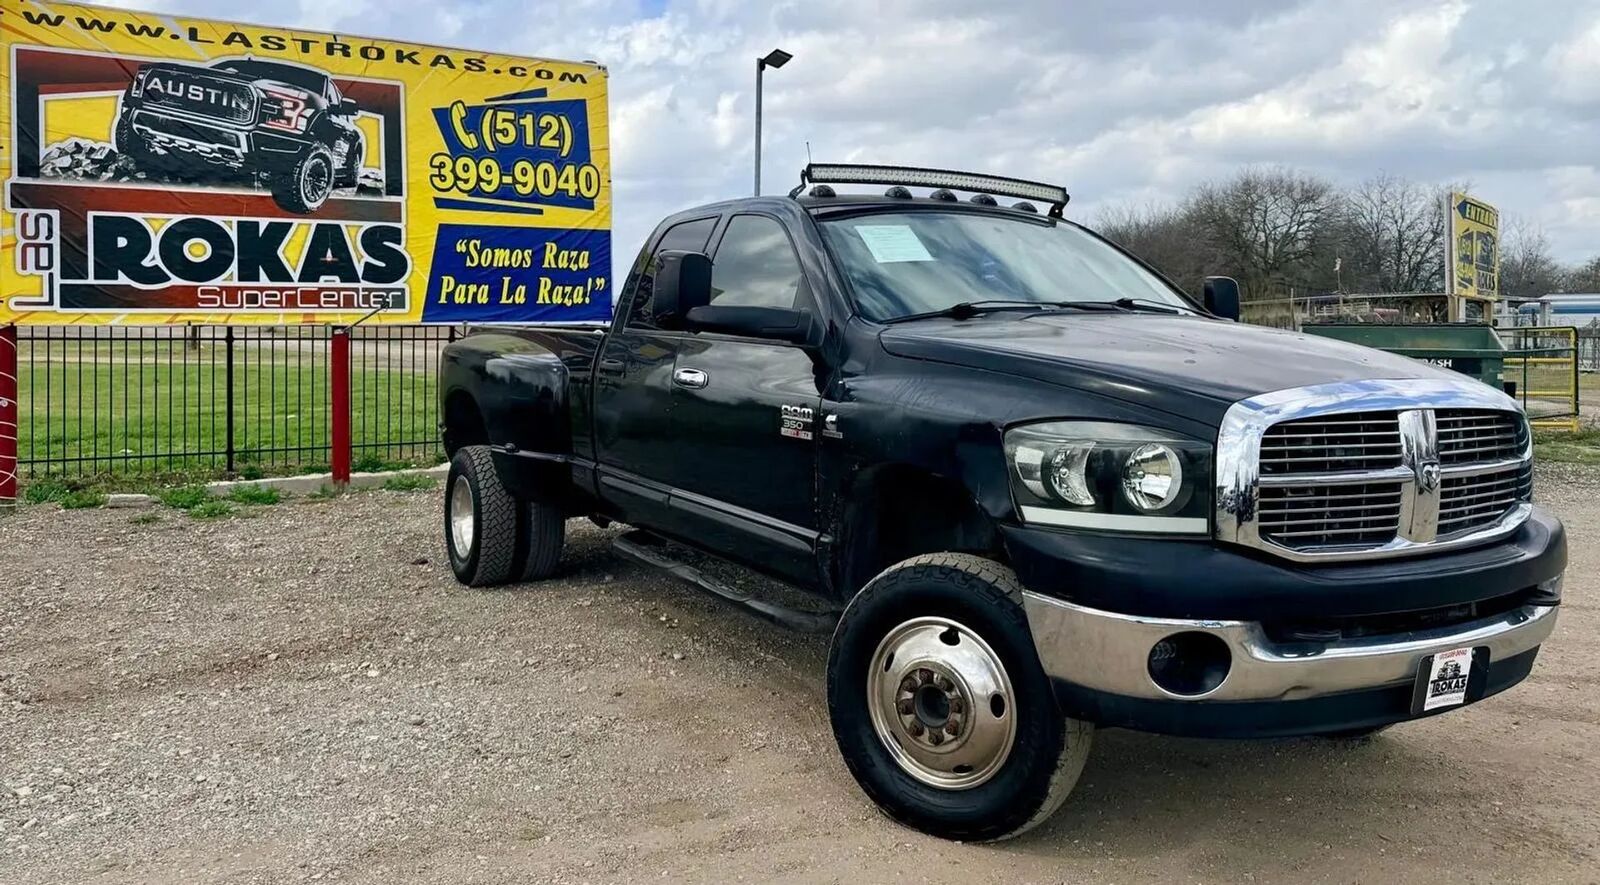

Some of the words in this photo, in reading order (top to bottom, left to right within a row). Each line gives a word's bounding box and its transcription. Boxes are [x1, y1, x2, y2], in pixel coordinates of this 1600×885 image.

[146, 77, 250, 110] AUSTIN
[480, 108, 573, 158] (512)
[430, 153, 600, 198] 399-9040
[542, 241, 590, 270] Raza
[438, 275, 489, 304] Para
[500, 276, 526, 304] La
